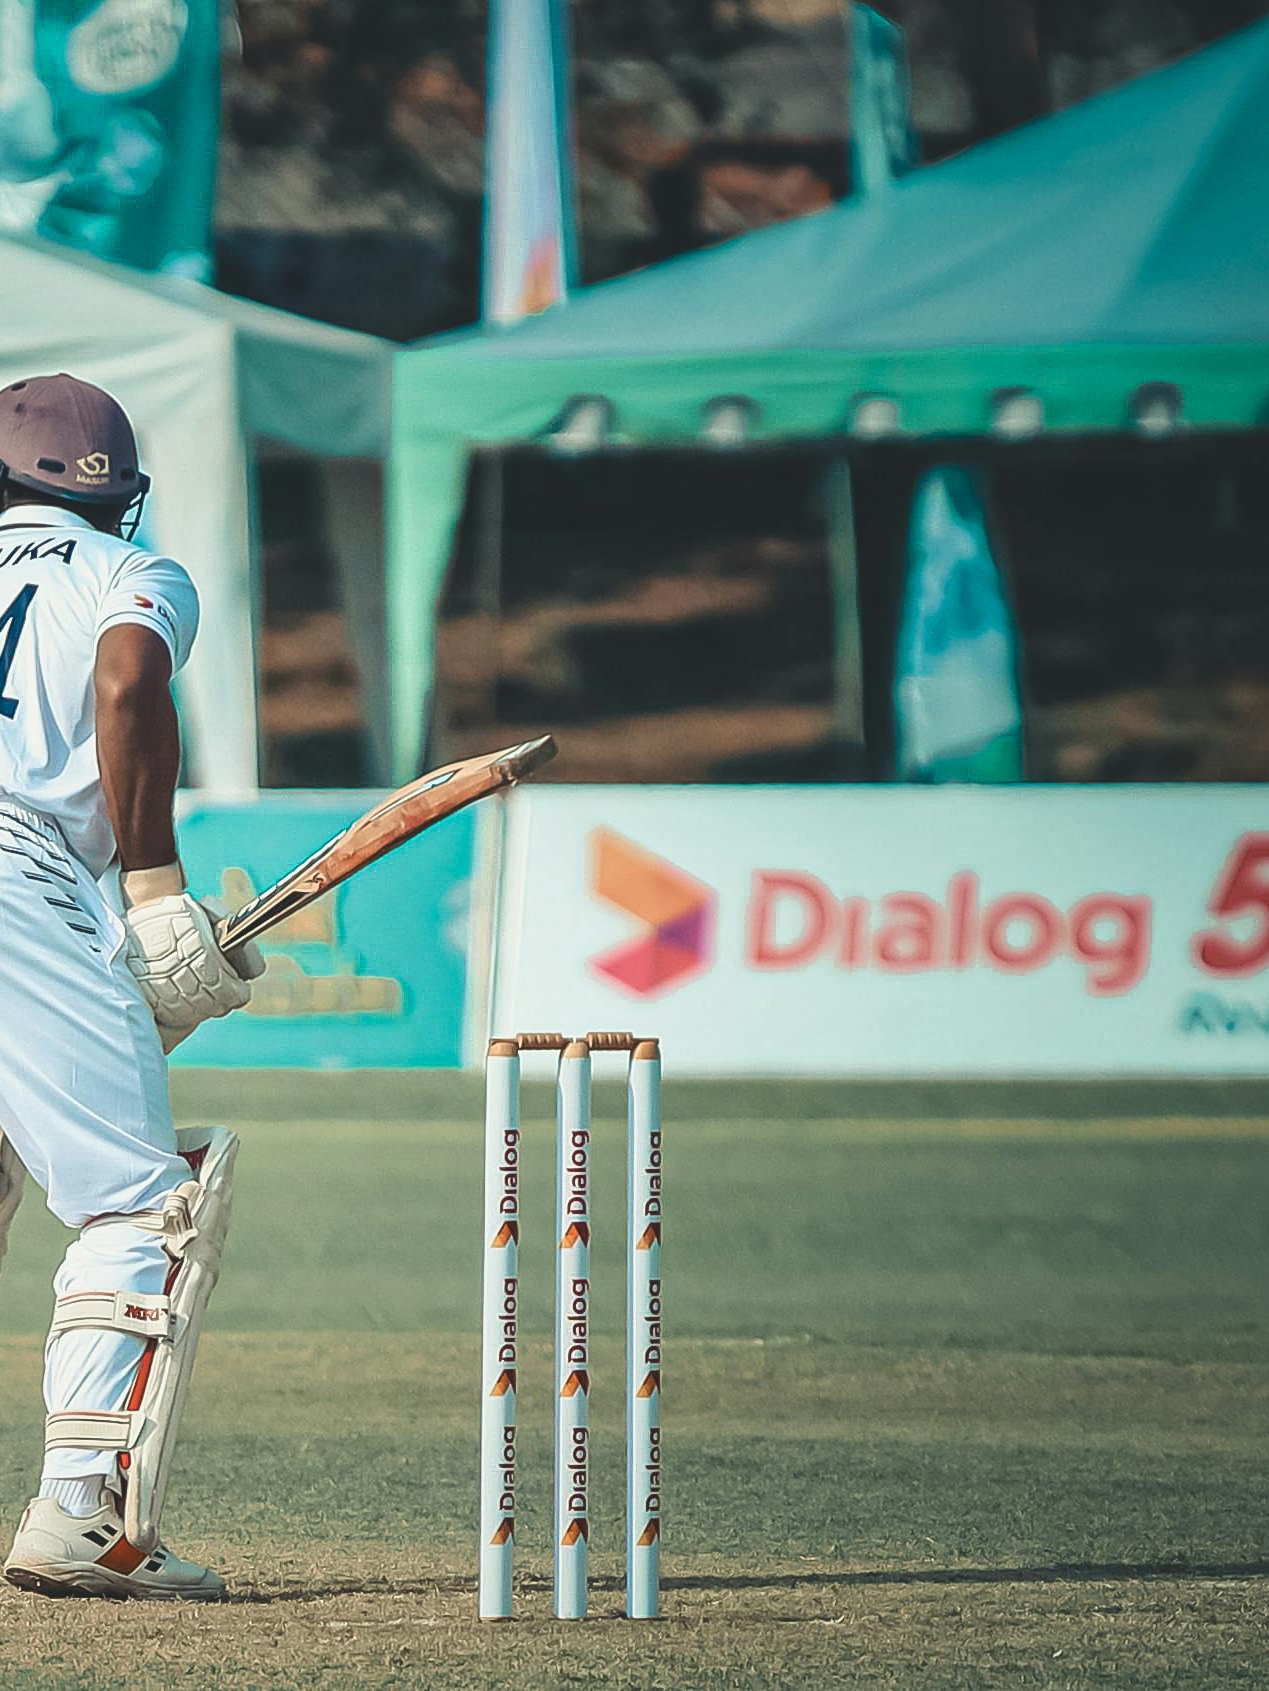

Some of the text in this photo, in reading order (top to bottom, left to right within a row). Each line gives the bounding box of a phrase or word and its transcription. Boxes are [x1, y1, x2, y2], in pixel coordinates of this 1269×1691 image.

[746, 868, 1152, 997] Dialog
[500, 1129, 520, 1214] Dialog
[567, 1130, 590, 1215] Dialog
[498, 1278, 518, 1363] Dialog
[567, 1279, 590, 1363] Dialog
[568, 1427, 590, 1512] Dialog
